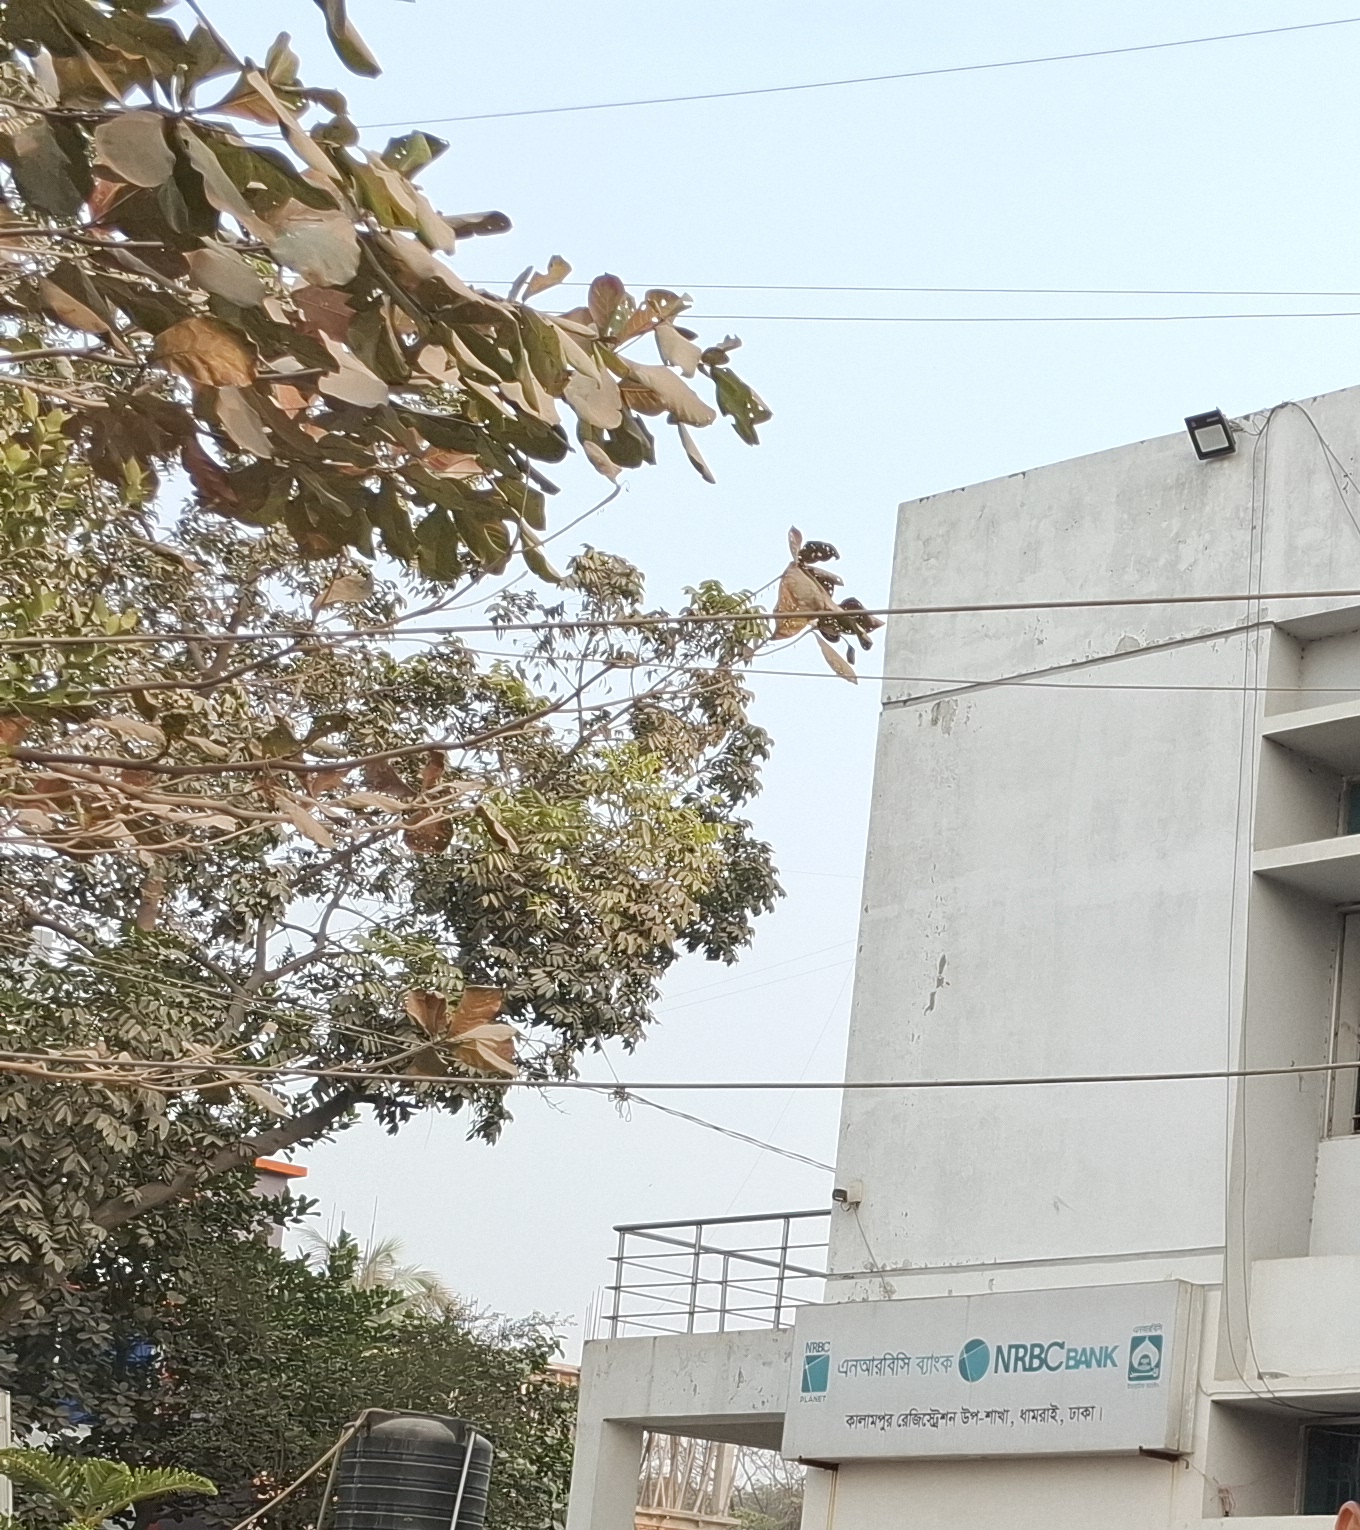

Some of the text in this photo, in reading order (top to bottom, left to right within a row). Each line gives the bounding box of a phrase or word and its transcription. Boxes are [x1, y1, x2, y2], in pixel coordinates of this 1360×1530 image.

[805, 1342, 830, 1353] NRBC
[838, 1351, 954, 1378] এনআরবিসি ব্যাংক
[800, 1395, 826, 1403] PLANET
[845, 1413, 895, 1432] কালামপুর
